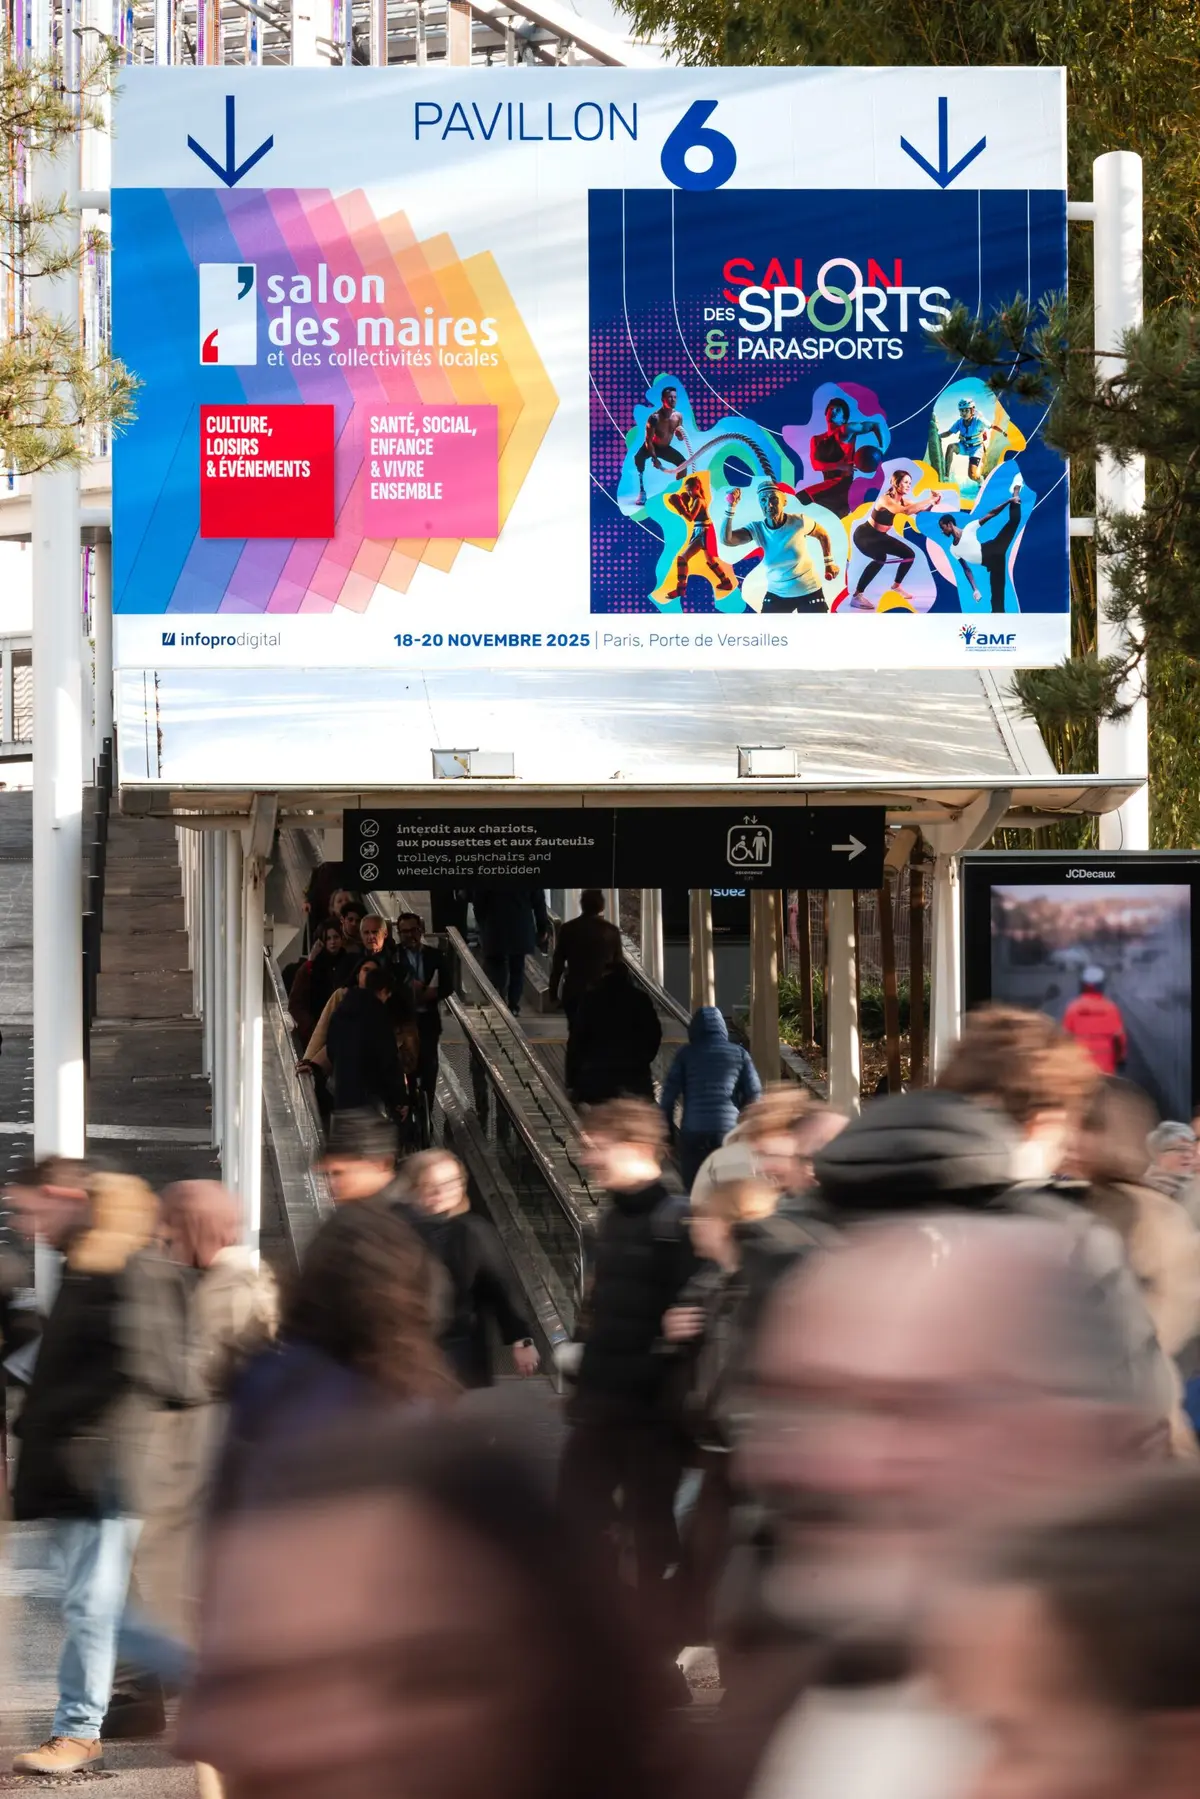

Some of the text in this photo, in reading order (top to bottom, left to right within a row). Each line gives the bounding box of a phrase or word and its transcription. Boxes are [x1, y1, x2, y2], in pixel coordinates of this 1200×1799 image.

[414, 99, 737, 191] PAVILLON 6
[267, 263, 385, 304] salon
[723, 257, 903, 304] SALON
[704, 285, 952, 333] DES SPORTS
[267, 305, 499, 347] des maires
[704, 329, 904, 360] & PARASPORTS
[267, 348, 499, 367] et des collectivités locales
[206, 415, 273, 437] CULTURE,
[370, 412, 477, 437] SANTÉ, SOCIAL,
[206, 438, 259, 456] LOISIRS
[370, 438, 434, 456] ENFANCE
[206, 458, 311, 478] & ÉVÉNEMENTS
[370, 461, 424, 478] & VIVRE
[370, 482, 443, 500] ENSEMBLE
[180, 632, 281, 649] infoprodigital
[393, 633, 590, 647] 18-20 NOVEMBRE 2025
[603, 633, 789, 648] Paris, Porte de Versailles
[396, 823, 538, 834] interdit aux chariots,
[396, 836, 595, 848] aux poussettes et aux fauteuils
[397, 852, 552, 864] trolleys, pushchairs and
[396, 865, 541, 875] wheelchairs forbidden
[1065, 869, 1116, 879] JCDecaux
